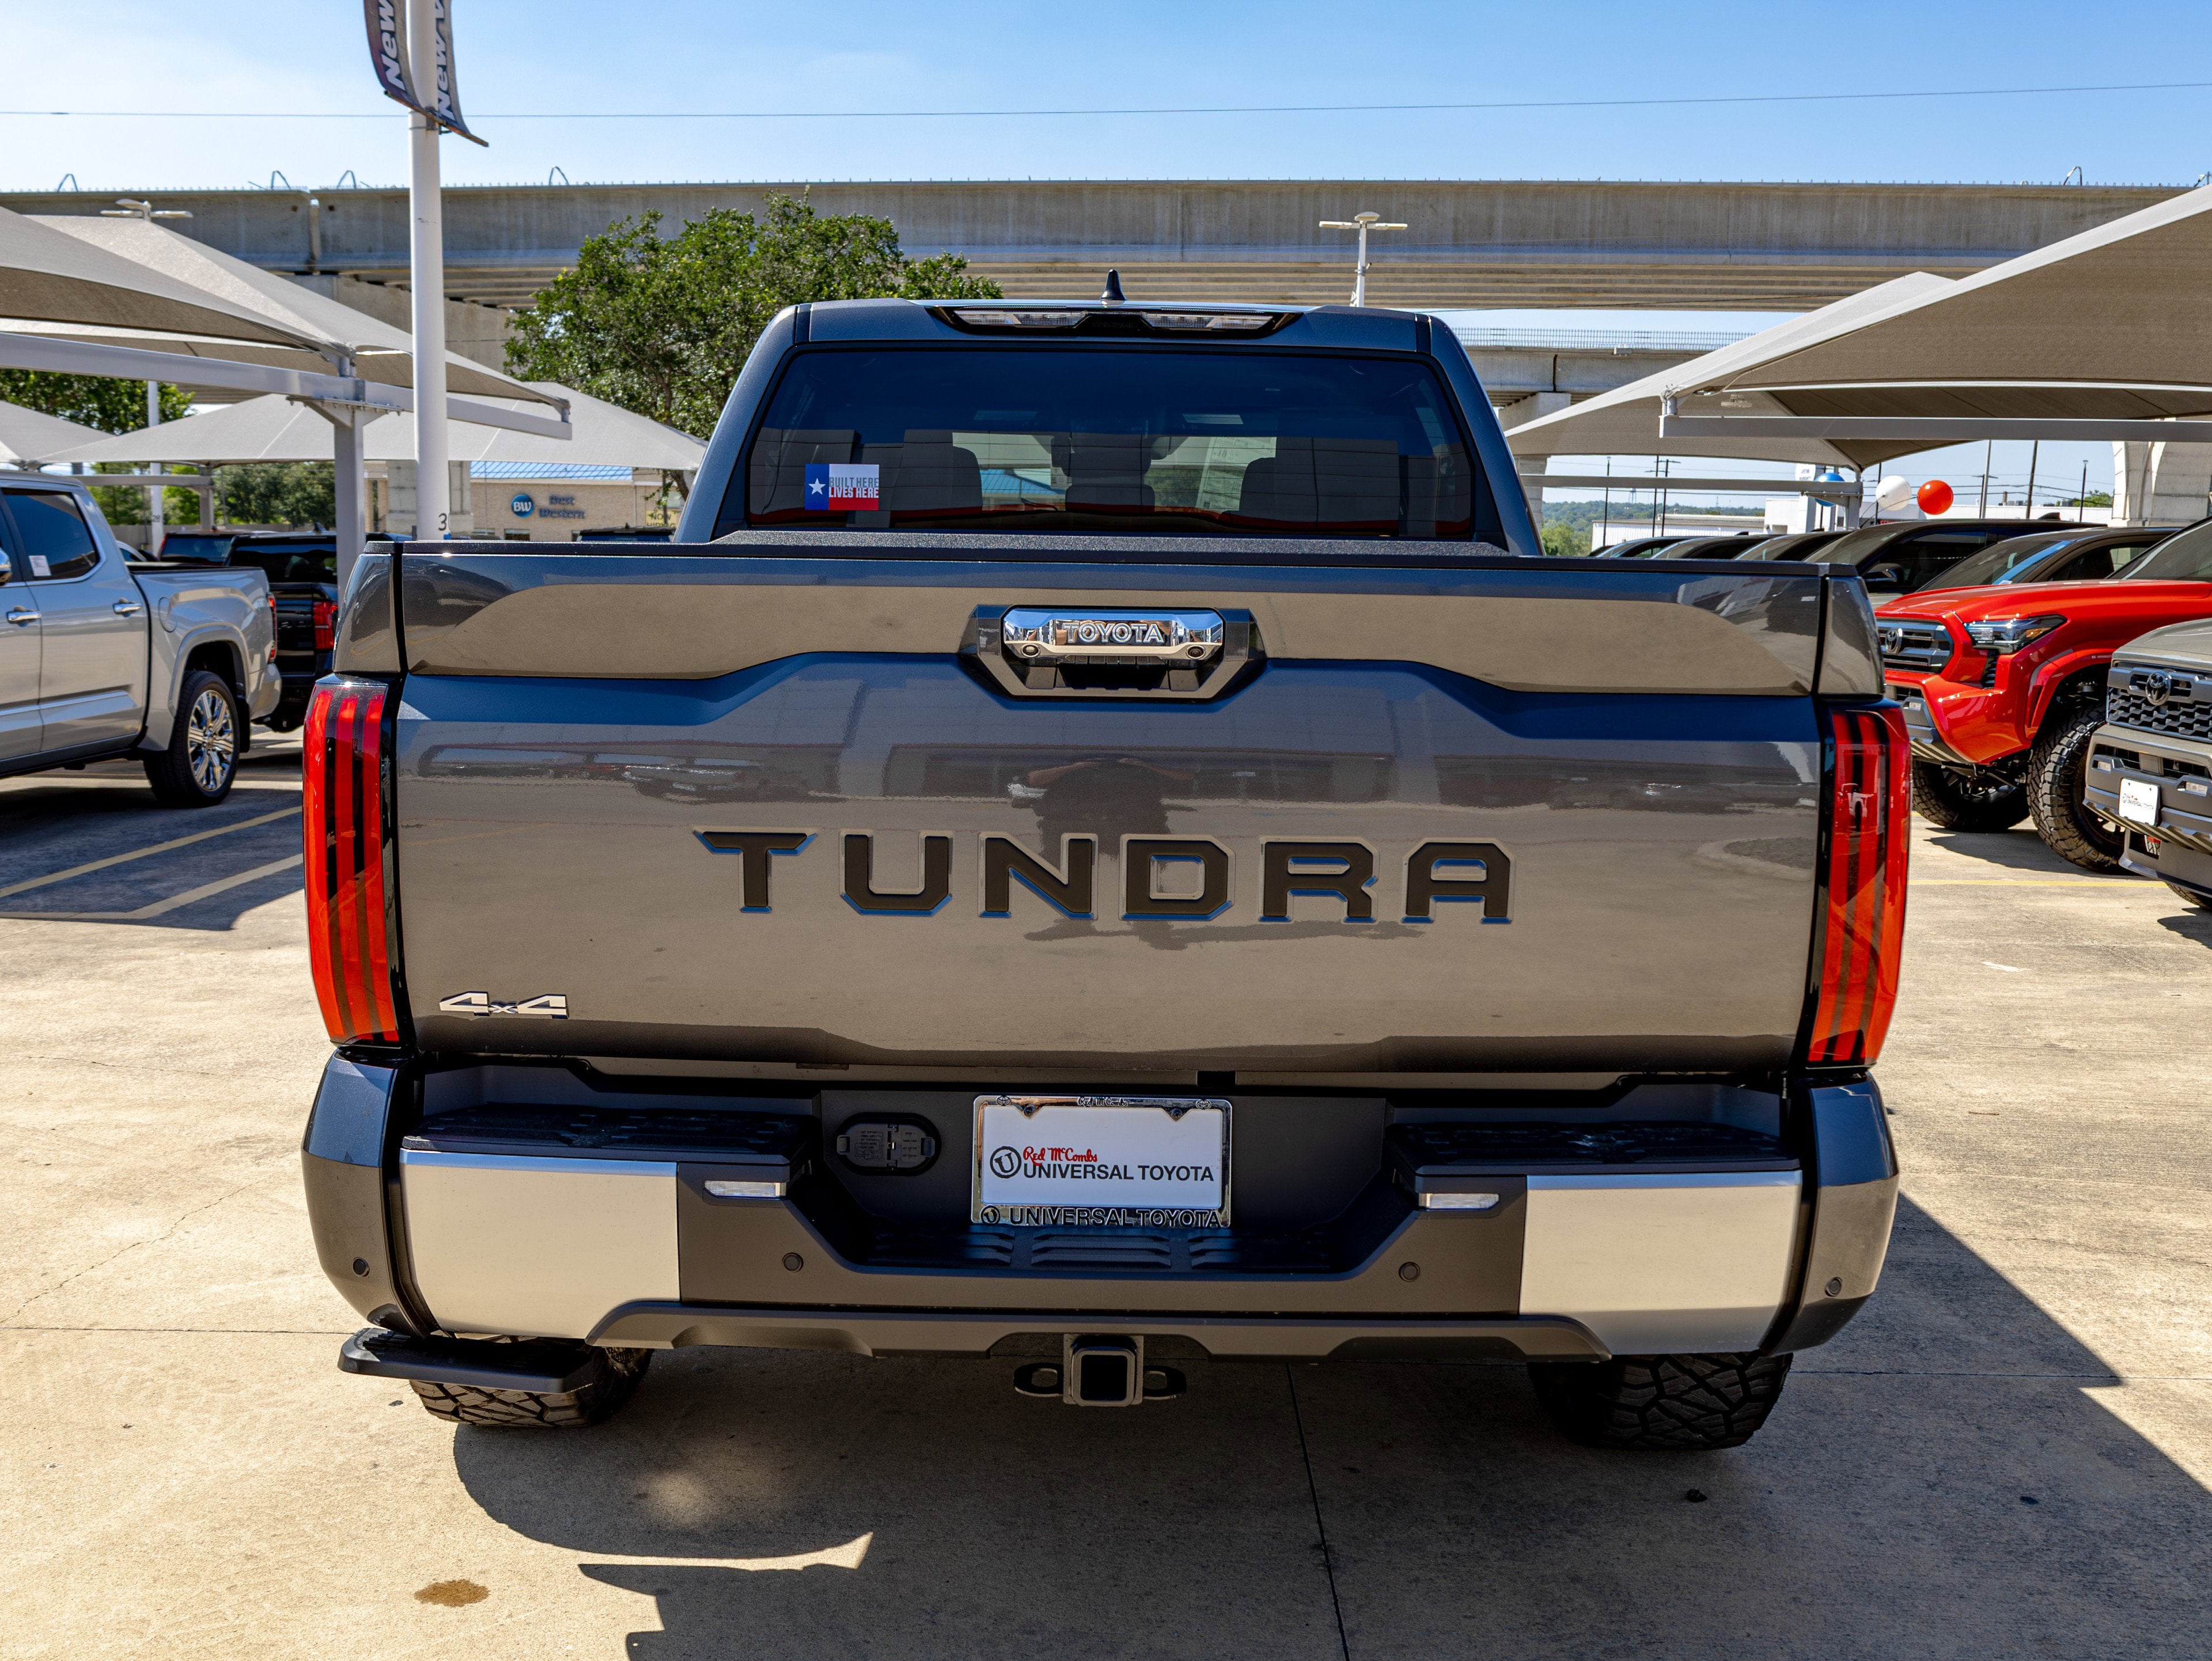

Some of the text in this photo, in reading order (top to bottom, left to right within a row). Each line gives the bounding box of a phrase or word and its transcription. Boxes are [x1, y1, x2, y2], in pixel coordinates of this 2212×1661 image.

[379, 0, 406, 91] New
[436, 29, 457, 123] New
[829, 477, 879, 488] BUILT HERE
[829, 487, 879, 498] LIVES HERE
[513, 501, 532, 512] BW
[549, 495, 575, 505] Best
[438, 513, 448, 531] 3
[538, 508, 585, 519] Western
[1063, 623, 1164, 644] TOYOTA
[693, 829, 1516, 924] TUNDRA
[439, 991, 568, 1019] 4x4
[1023, 1146, 1046, 1167] Red
[1024, 1163, 1214, 1182] UNIVERSAL TOYOTA
[1010, 1207, 1222, 1228] UNIVERSAL TOYOTA
